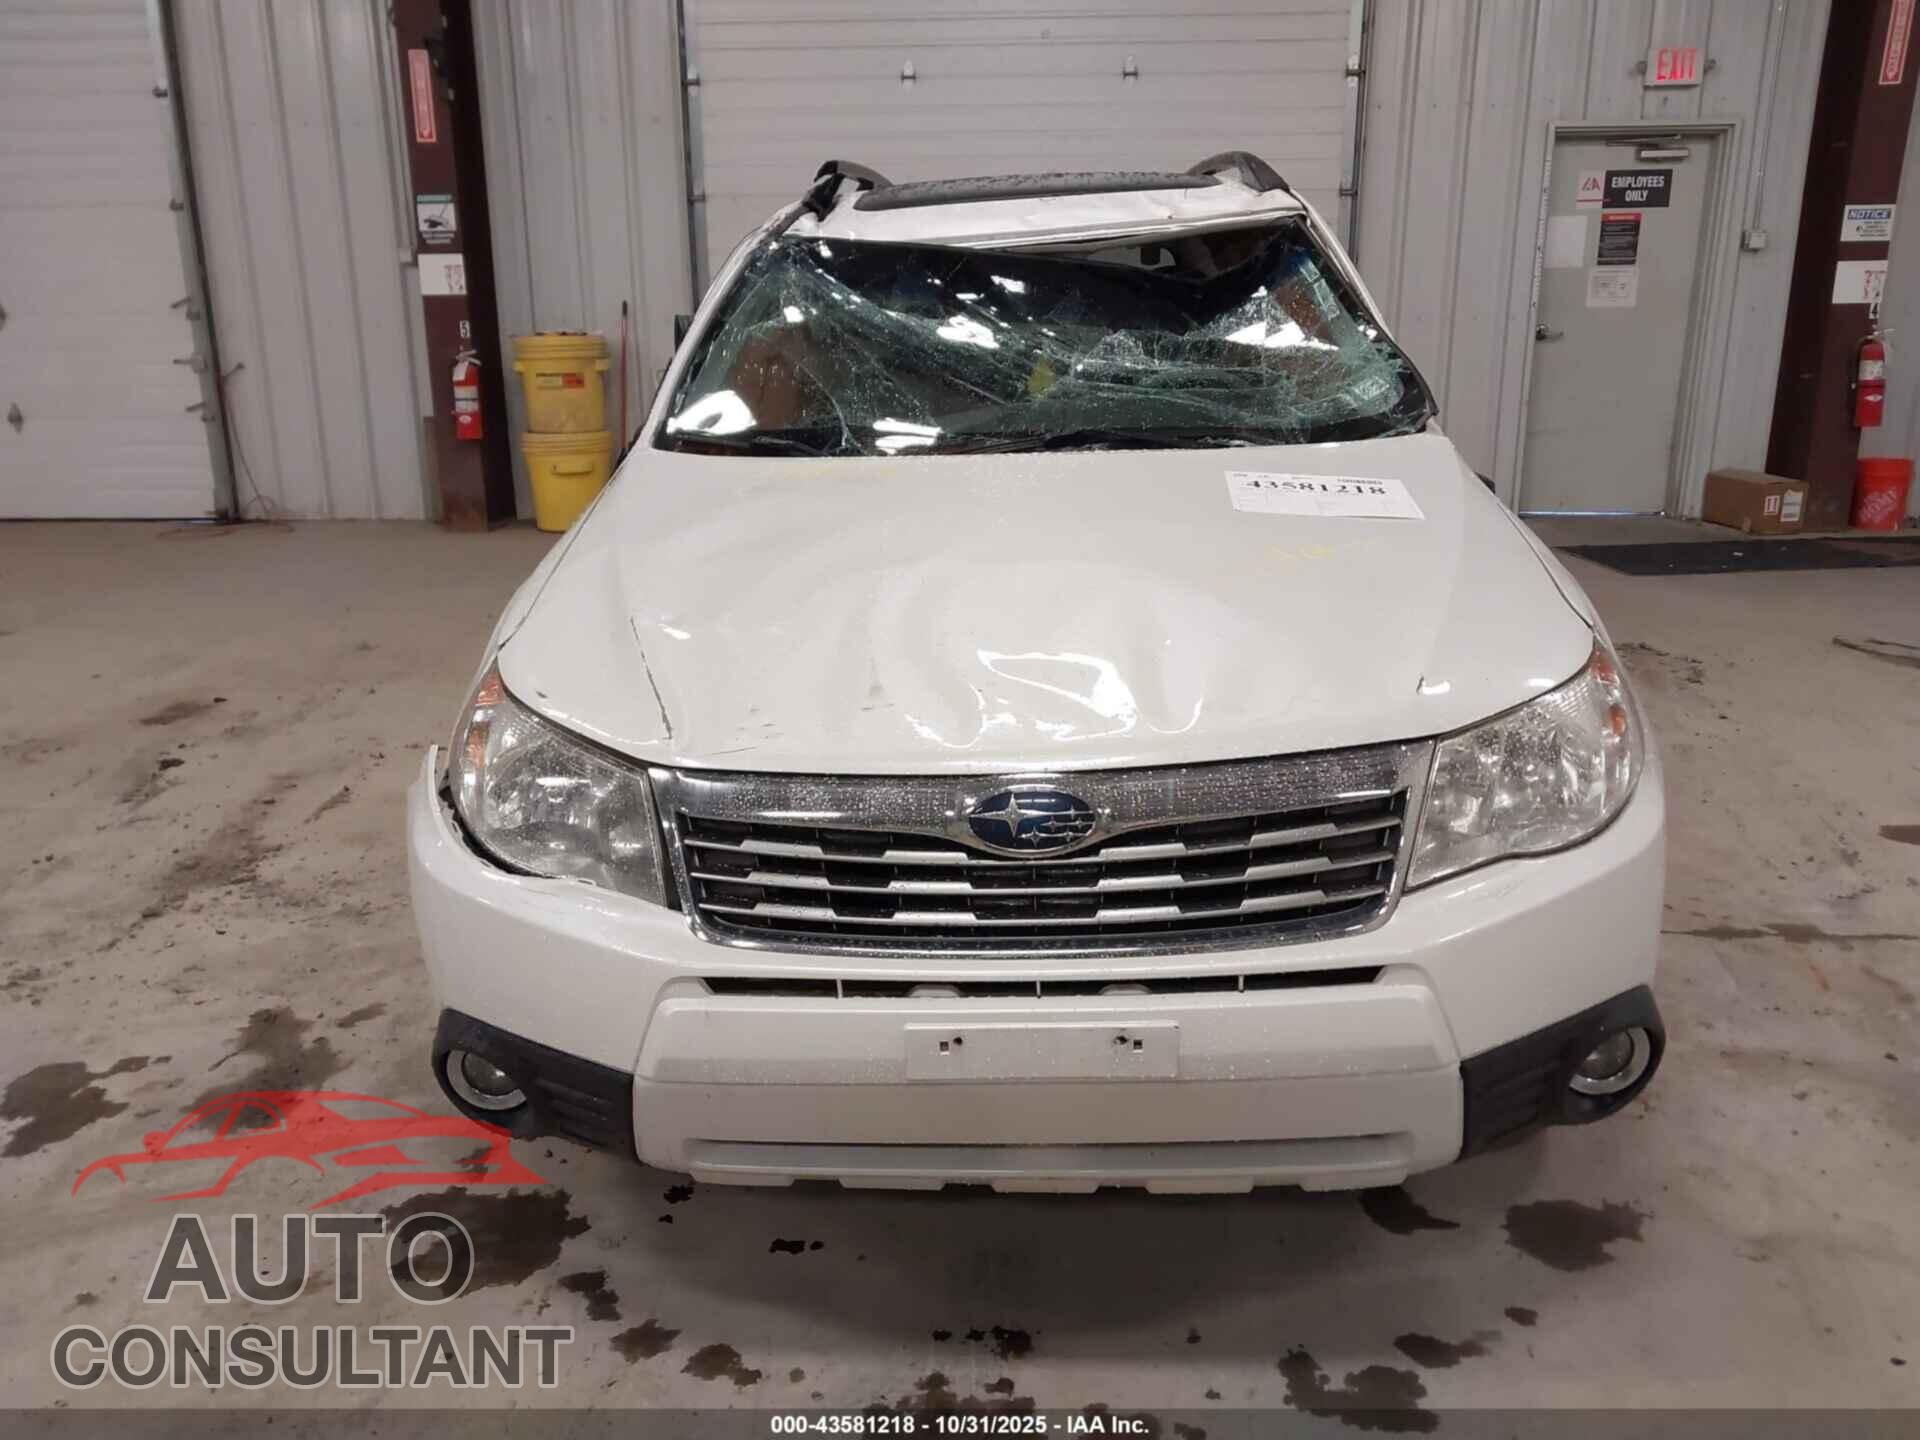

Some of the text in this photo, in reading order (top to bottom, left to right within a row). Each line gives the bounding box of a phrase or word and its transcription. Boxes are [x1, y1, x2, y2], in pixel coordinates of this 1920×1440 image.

[1656, 48, 1697, 81] EXIT
[1611, 176, 1665, 189] EMPLOYEES
[1625, 190, 1649, 202] ONLY
[1849, 209, 1889, 220] NOTICE
[1246, 480, 1386, 494] 43581218
